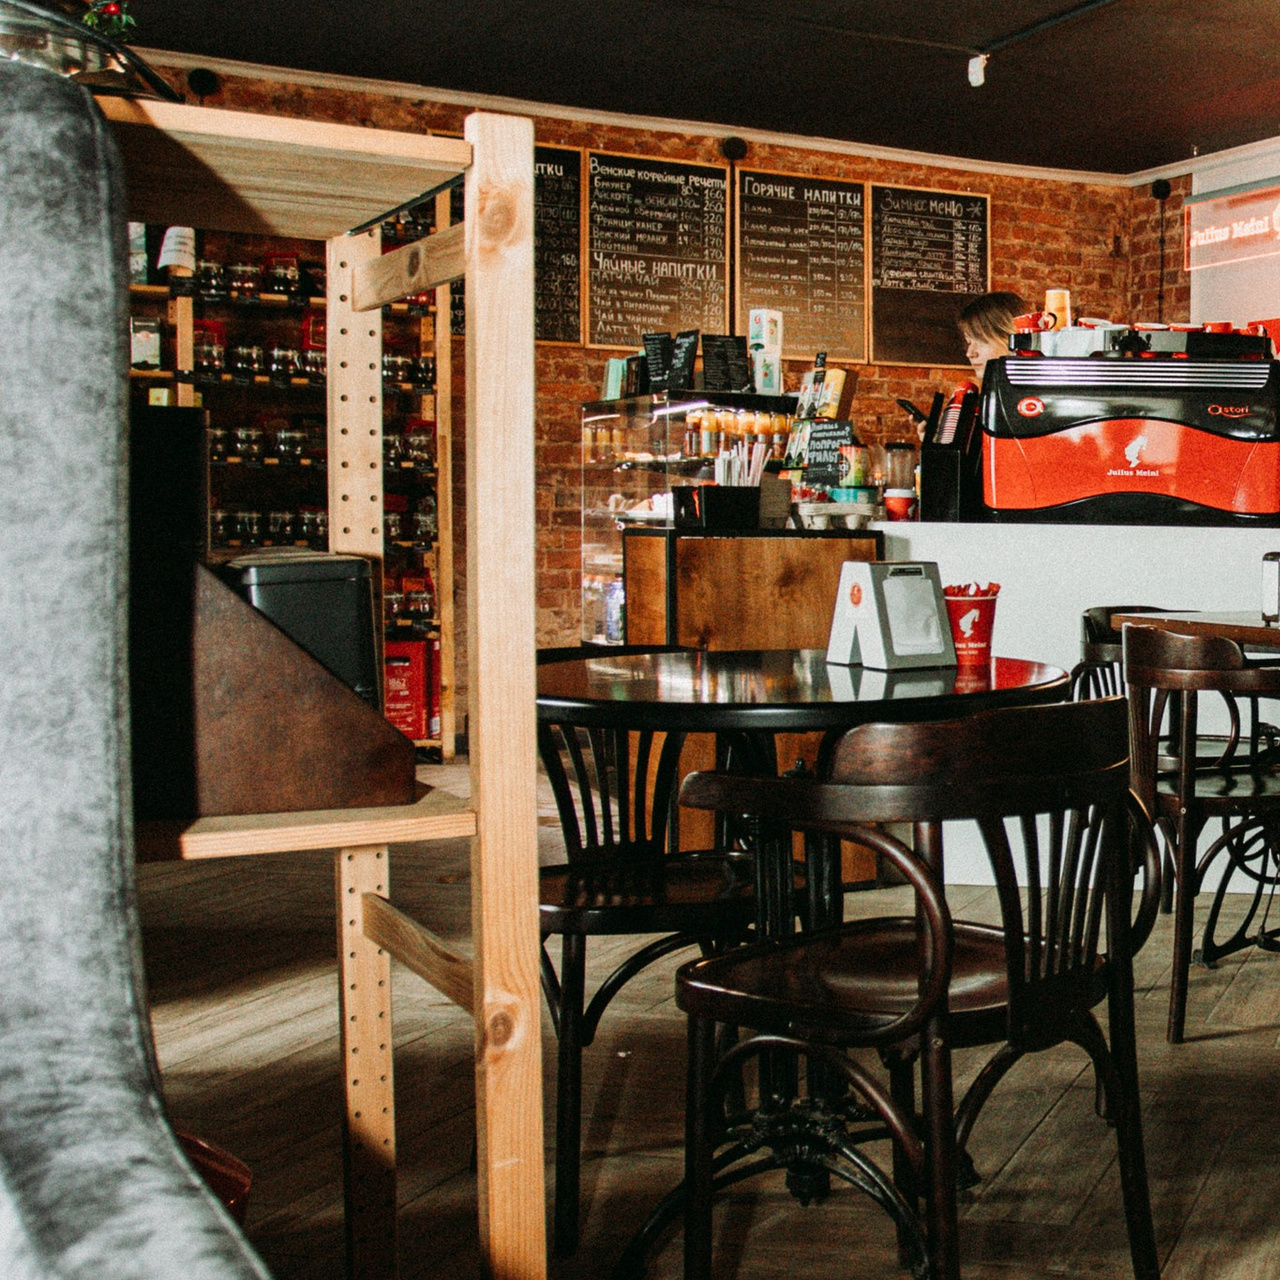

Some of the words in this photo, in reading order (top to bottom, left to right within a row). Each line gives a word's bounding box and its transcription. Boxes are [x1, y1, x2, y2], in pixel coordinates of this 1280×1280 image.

[1190, 226, 1229, 248] Julius
[1231, 216, 1269, 239] Meinl
[1106, 468, 1134, 476] Julius
[1135, 469, 1160, 477] Meinl
[967, 641, 987, 649] Meinl
